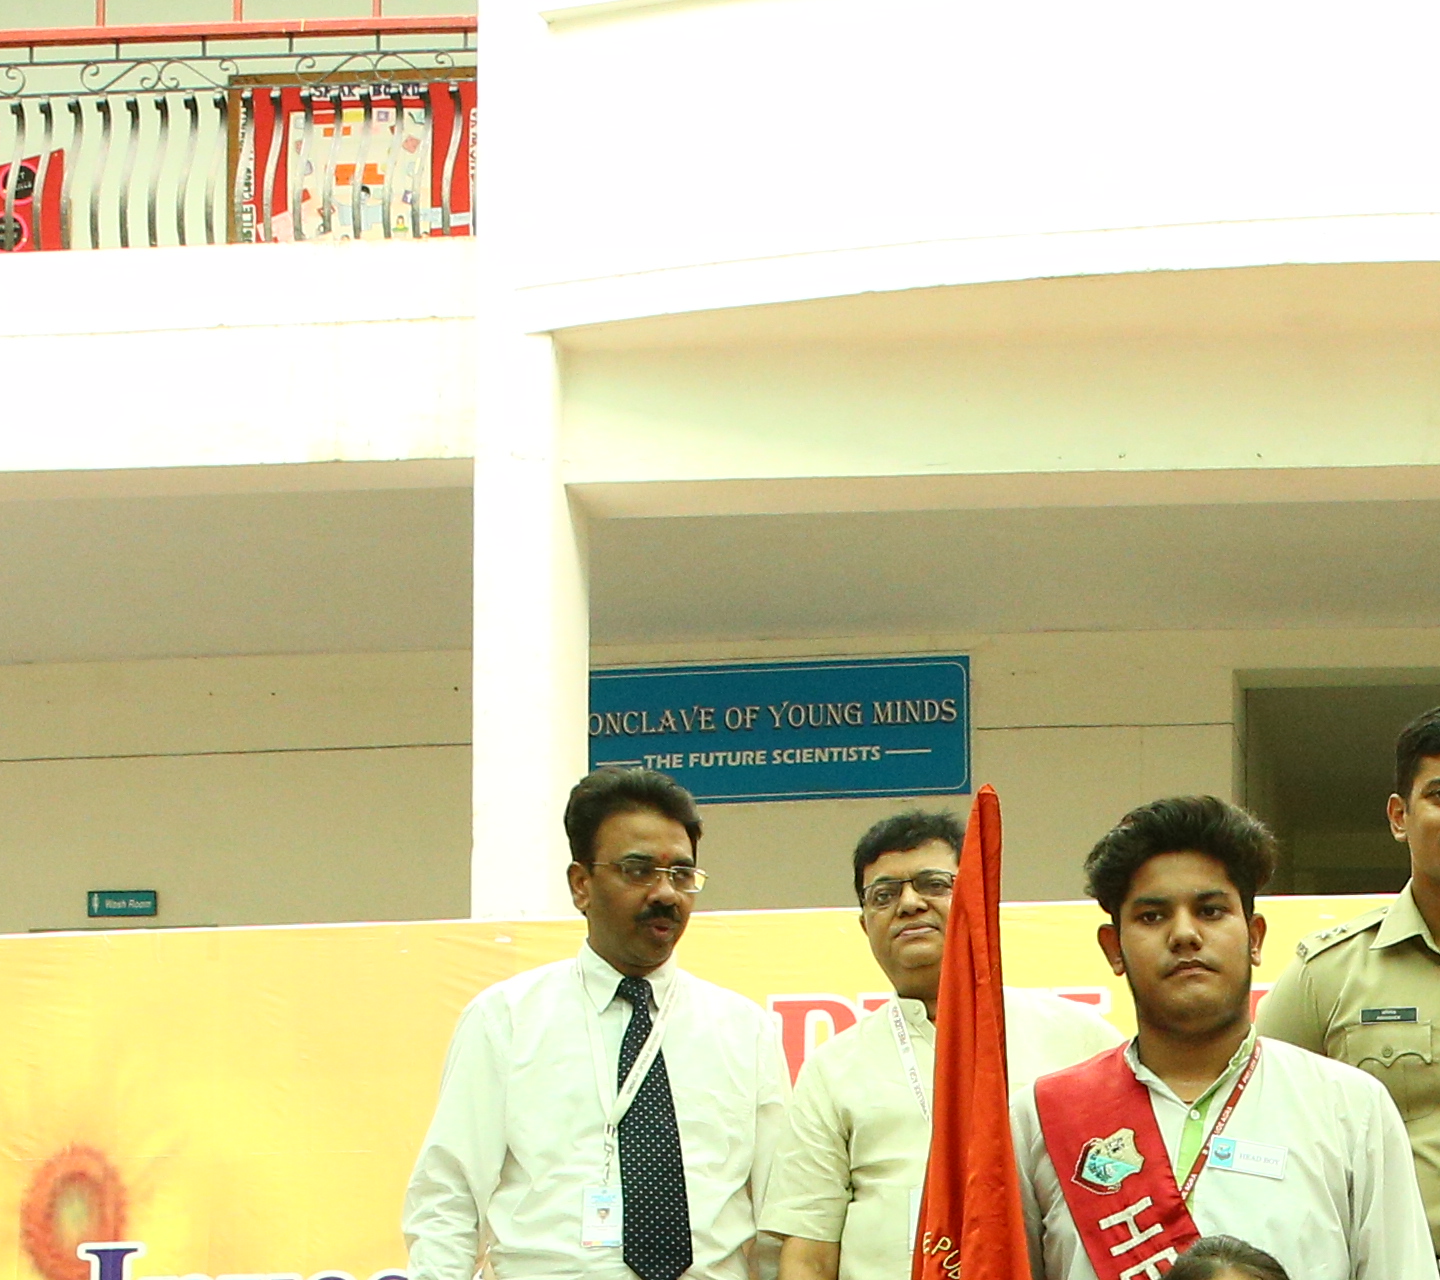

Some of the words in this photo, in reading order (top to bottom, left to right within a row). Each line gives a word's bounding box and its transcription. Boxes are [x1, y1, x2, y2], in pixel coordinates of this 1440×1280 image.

[589, 704, 716, 736] ONCLAVE
[724, 705, 761, 731] OF
[767, 700, 863, 729] YOUNG
[872, 698, 958, 726] MINDS
[643, 754, 684, 769] THE
[688, 750, 767, 768] FUTURE
[771, 746, 881, 765] SCIENTISTS
